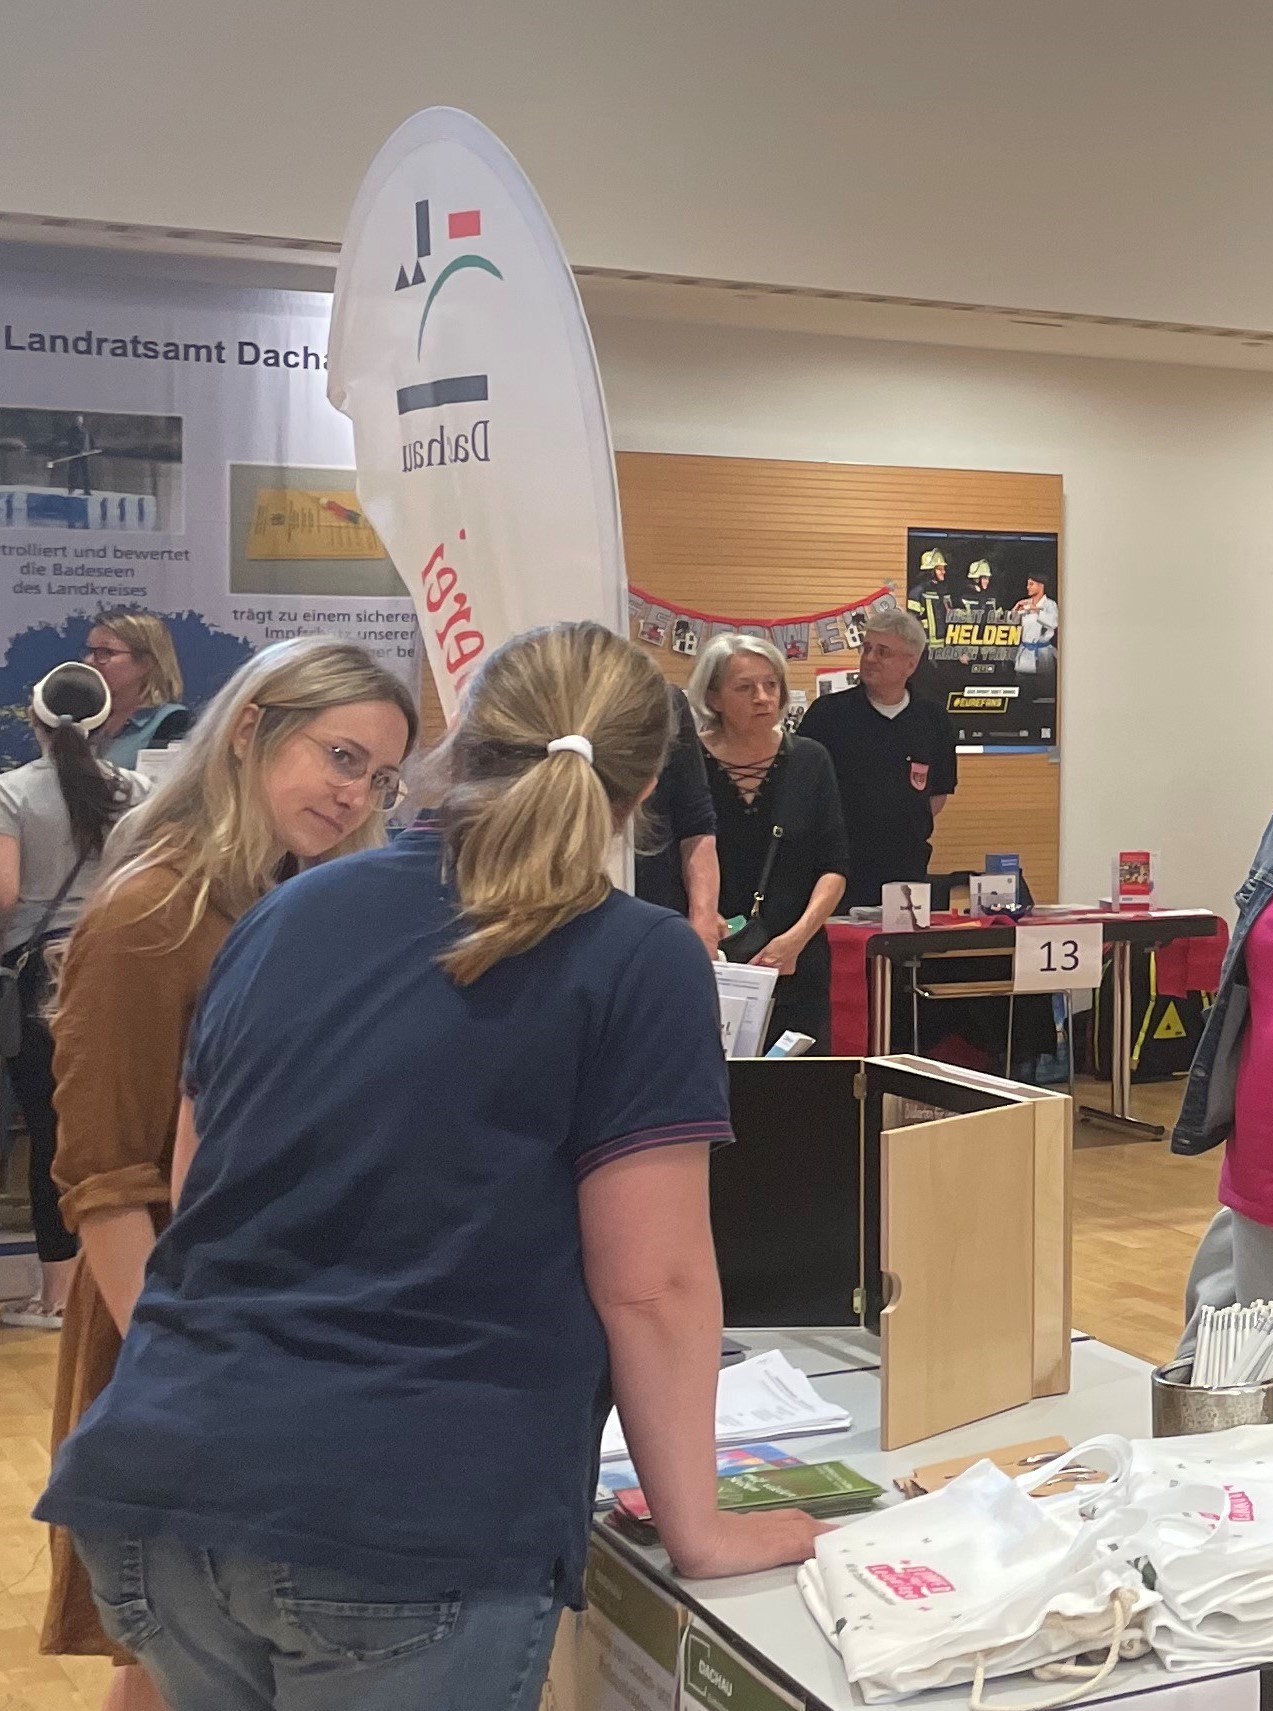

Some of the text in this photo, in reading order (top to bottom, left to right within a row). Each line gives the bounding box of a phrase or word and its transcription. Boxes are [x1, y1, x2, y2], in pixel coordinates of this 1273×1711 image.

[4, 325, 329, 370] Landratsamt Dach
[74, 547, 107, 559] und
[113, 545, 191, 562] bewertet
[20, 562, 135, 578] die Badeseen
[13, 581, 148, 597] des Landkreises
[233, 609, 274, 625] trägt
[278, 611, 298, 622] zu
[302, 610, 350, 622] einem
[945, 623, 1022, 646] HELDEN
[1040, 940, 1079, 972] 13
[697, 1659, 734, 1698] DACHAU
